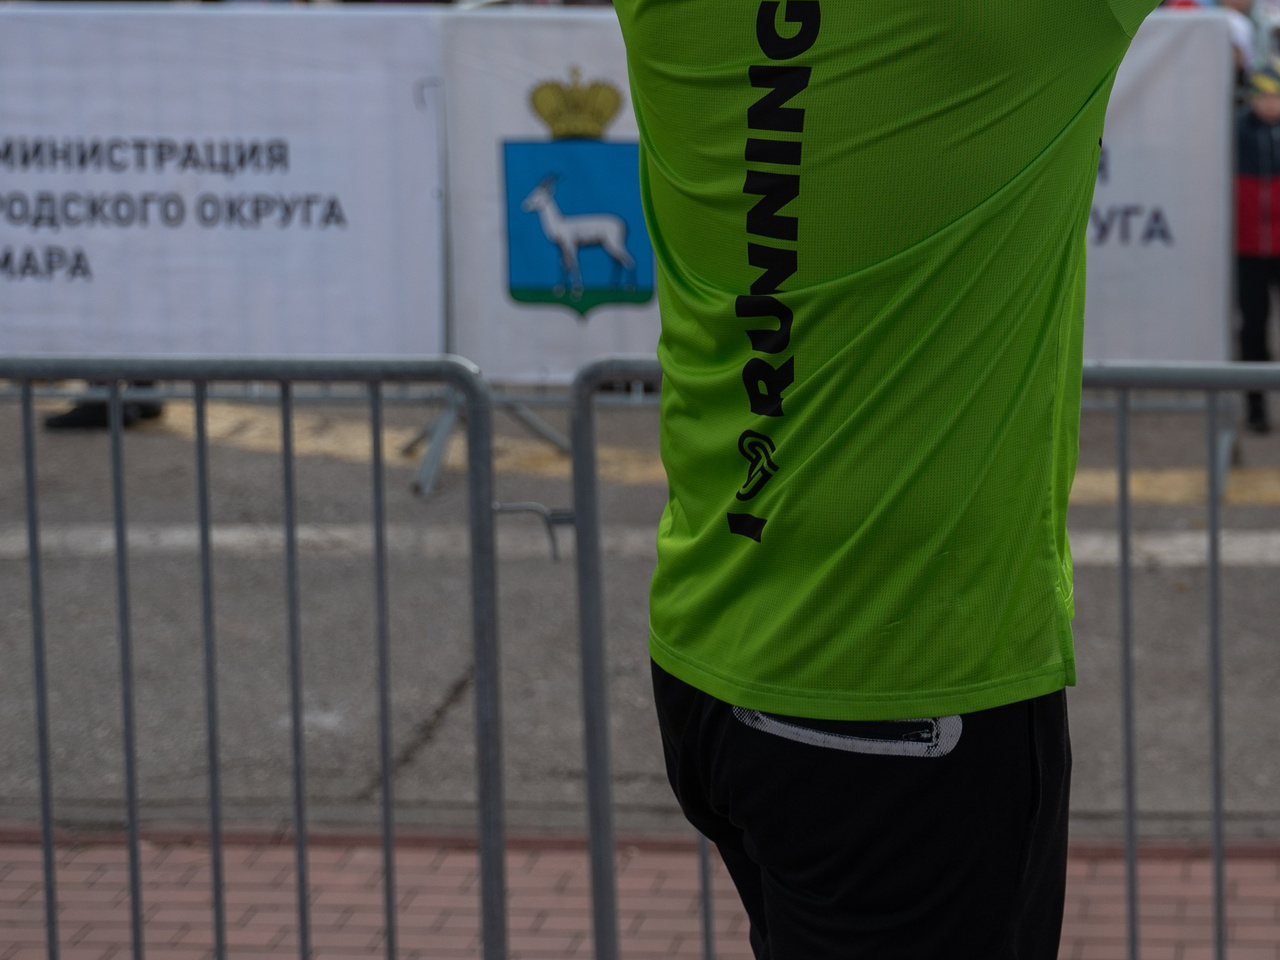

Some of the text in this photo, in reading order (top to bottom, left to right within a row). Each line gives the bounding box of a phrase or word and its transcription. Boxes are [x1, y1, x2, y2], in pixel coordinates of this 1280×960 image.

[0, 192, 348, 232] ОДСКОГО ОКРУГА
[735, 0, 821, 417] RUNNING
